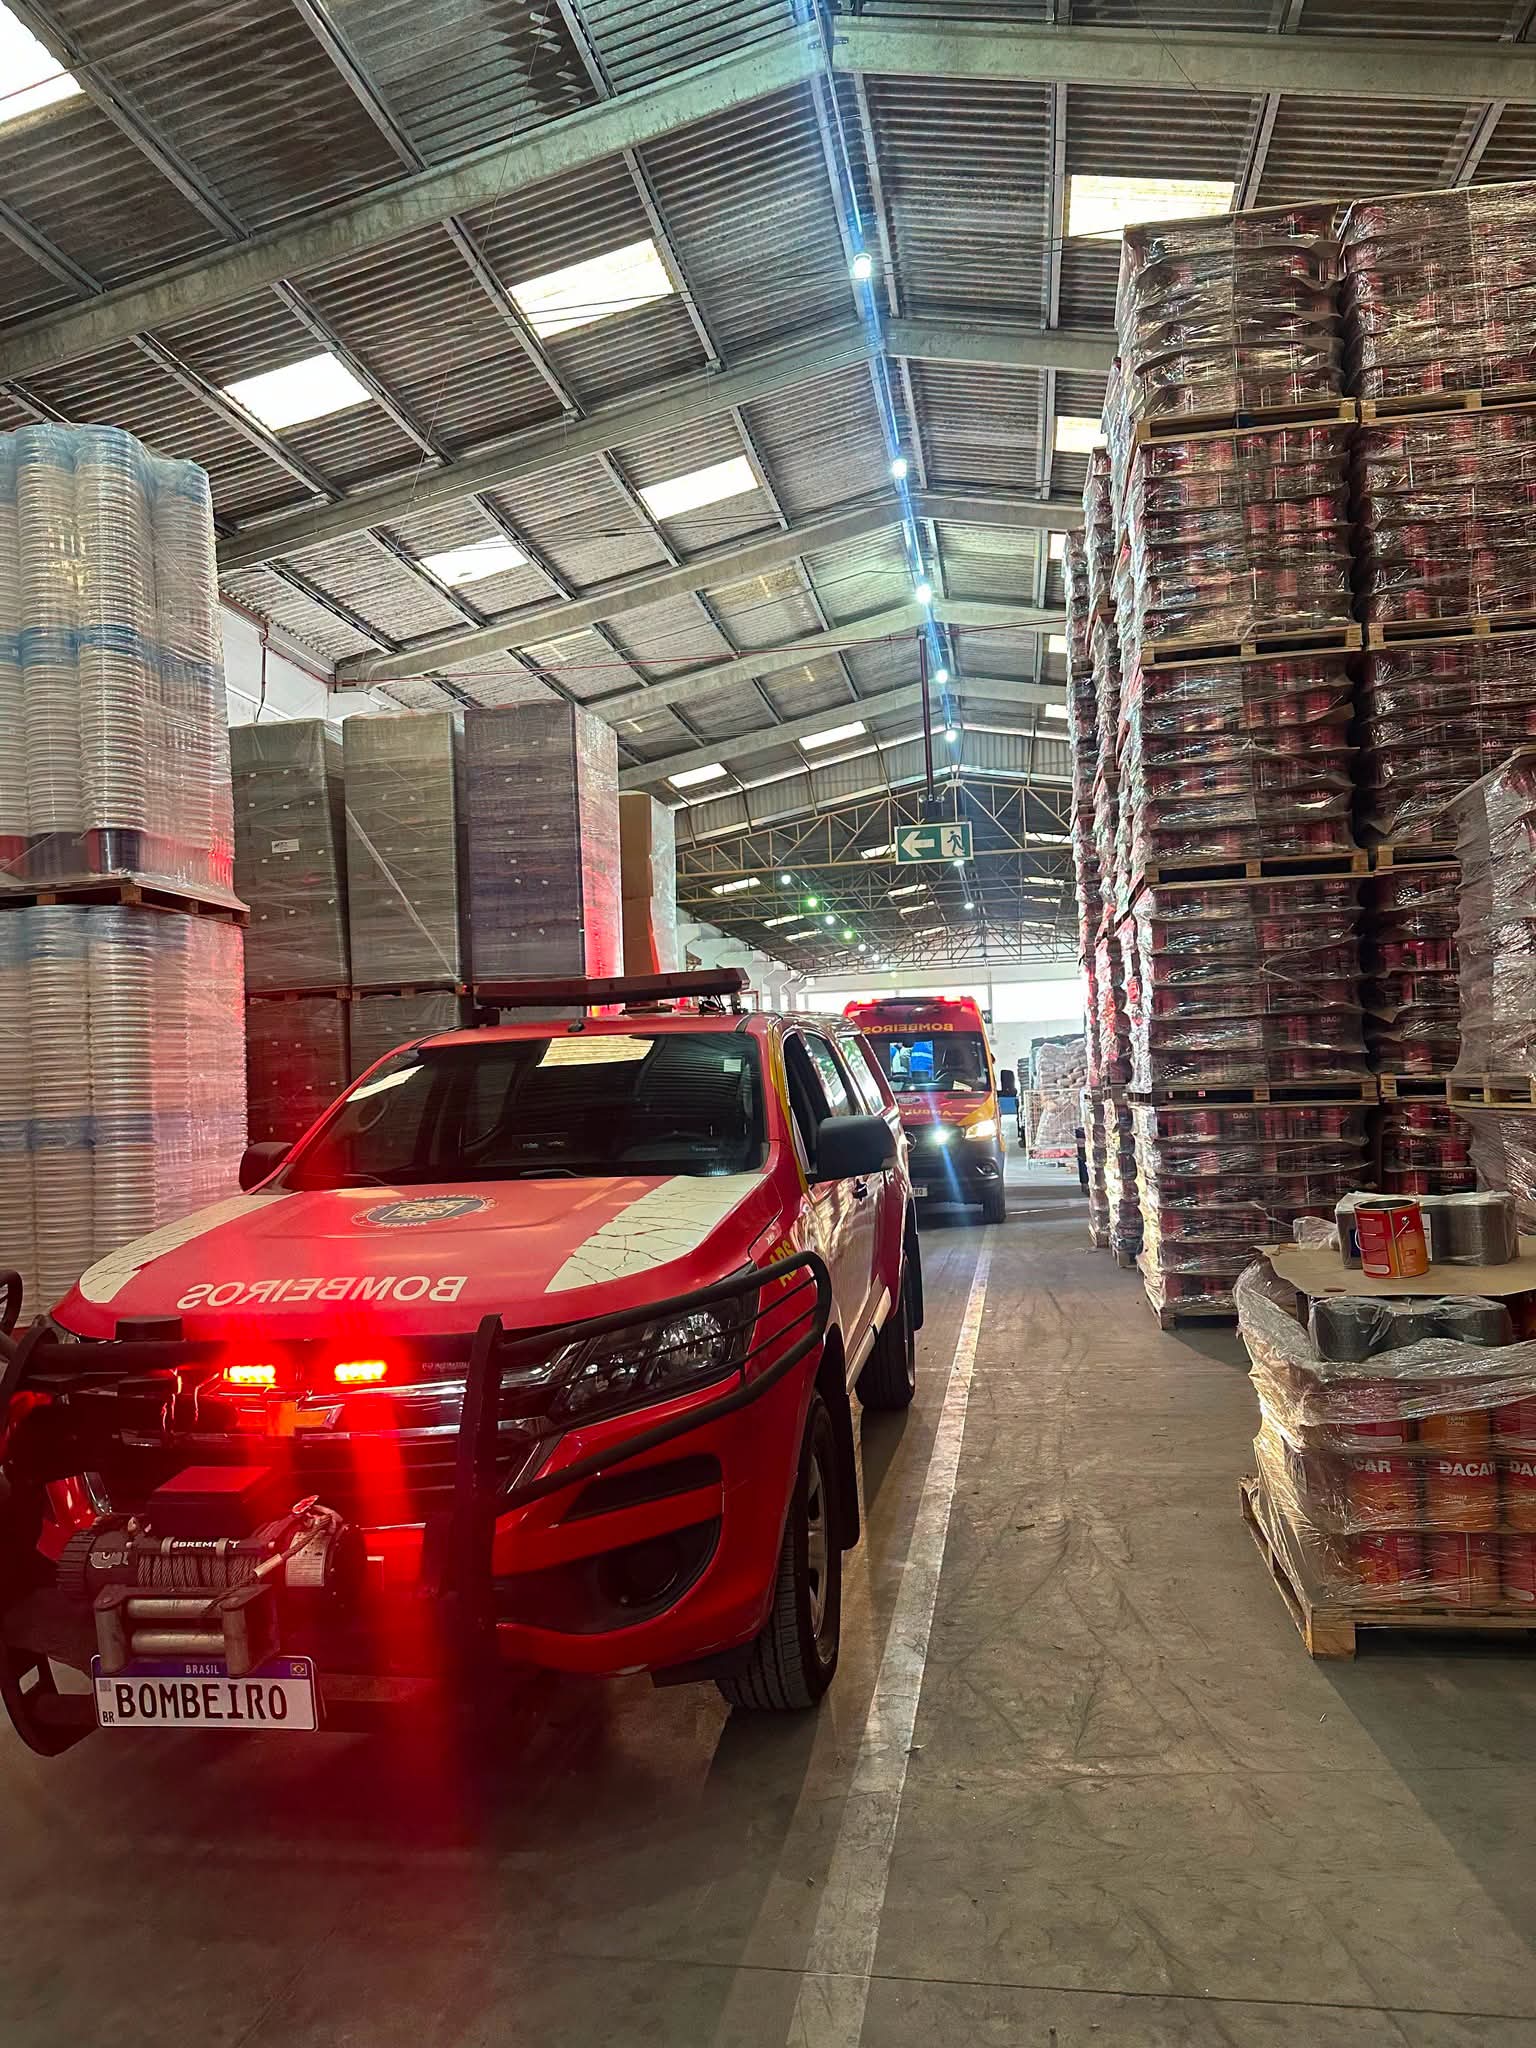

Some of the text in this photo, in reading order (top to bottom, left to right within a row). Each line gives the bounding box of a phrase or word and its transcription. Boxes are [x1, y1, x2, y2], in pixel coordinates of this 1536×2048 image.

[185, 1664, 220, 1674] BRASIL
[115, 1682, 288, 1721] BOMBEIRO
[102, 1711, 115, 1723] BR
